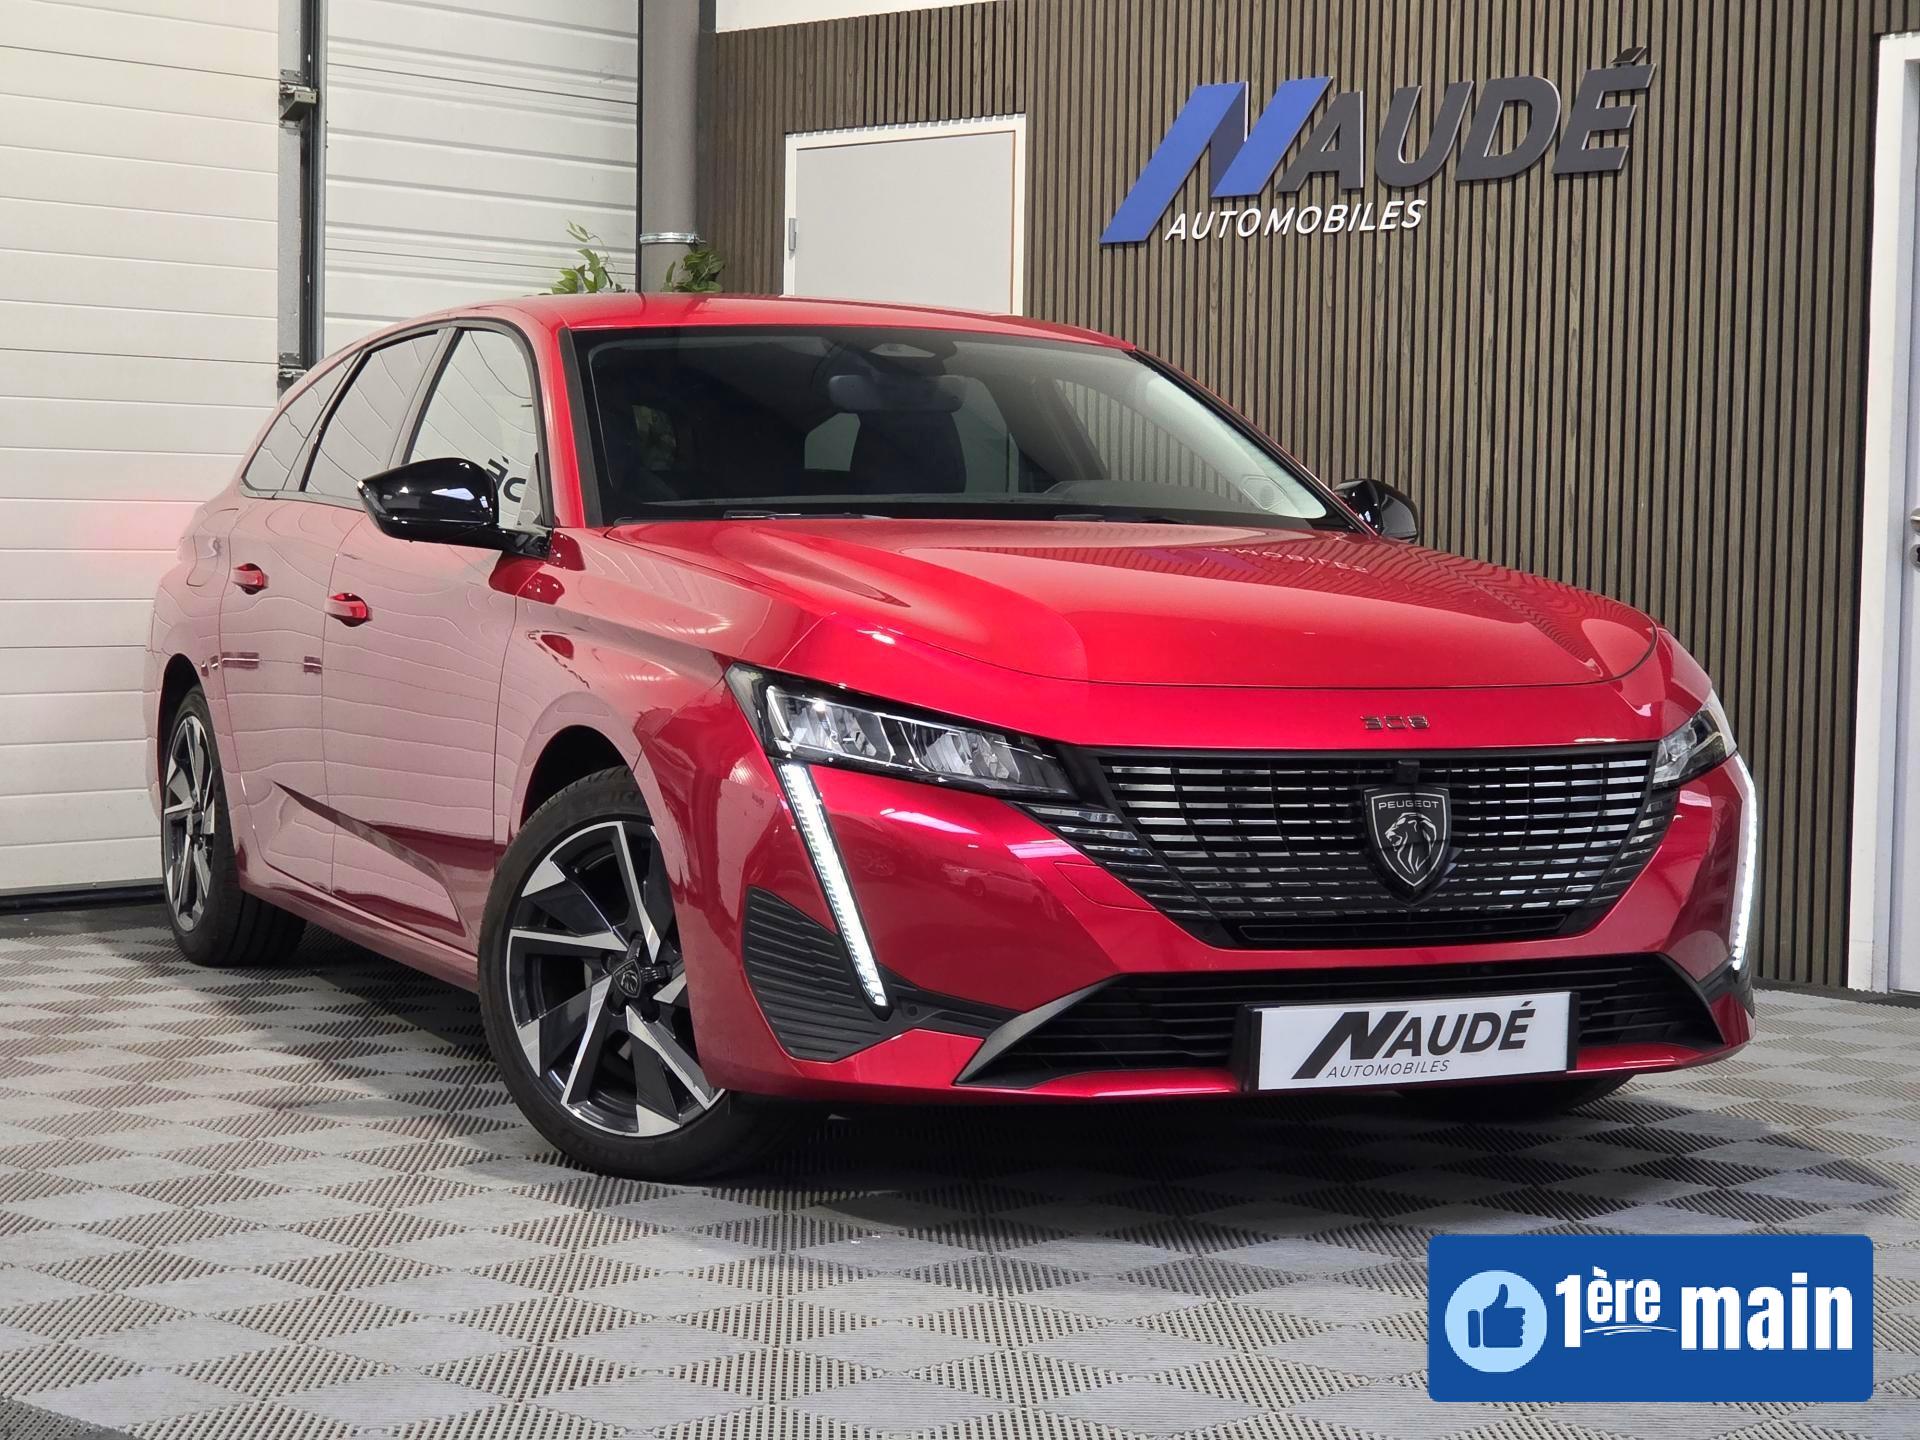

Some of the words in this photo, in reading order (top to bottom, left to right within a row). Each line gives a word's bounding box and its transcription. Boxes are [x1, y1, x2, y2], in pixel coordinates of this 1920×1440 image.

[1100, 46, 1657, 244] NAUDÉ
[1164, 199, 1427, 241] AUTOMOBILES
[1360, 714, 1430, 730] 308
[1378, 800, 1439, 810] PEUGEOT
[1291, 1001, 1536, 1080] NAUDÉ
[1326, 1059, 1451, 1079] AUTOMOBILES
